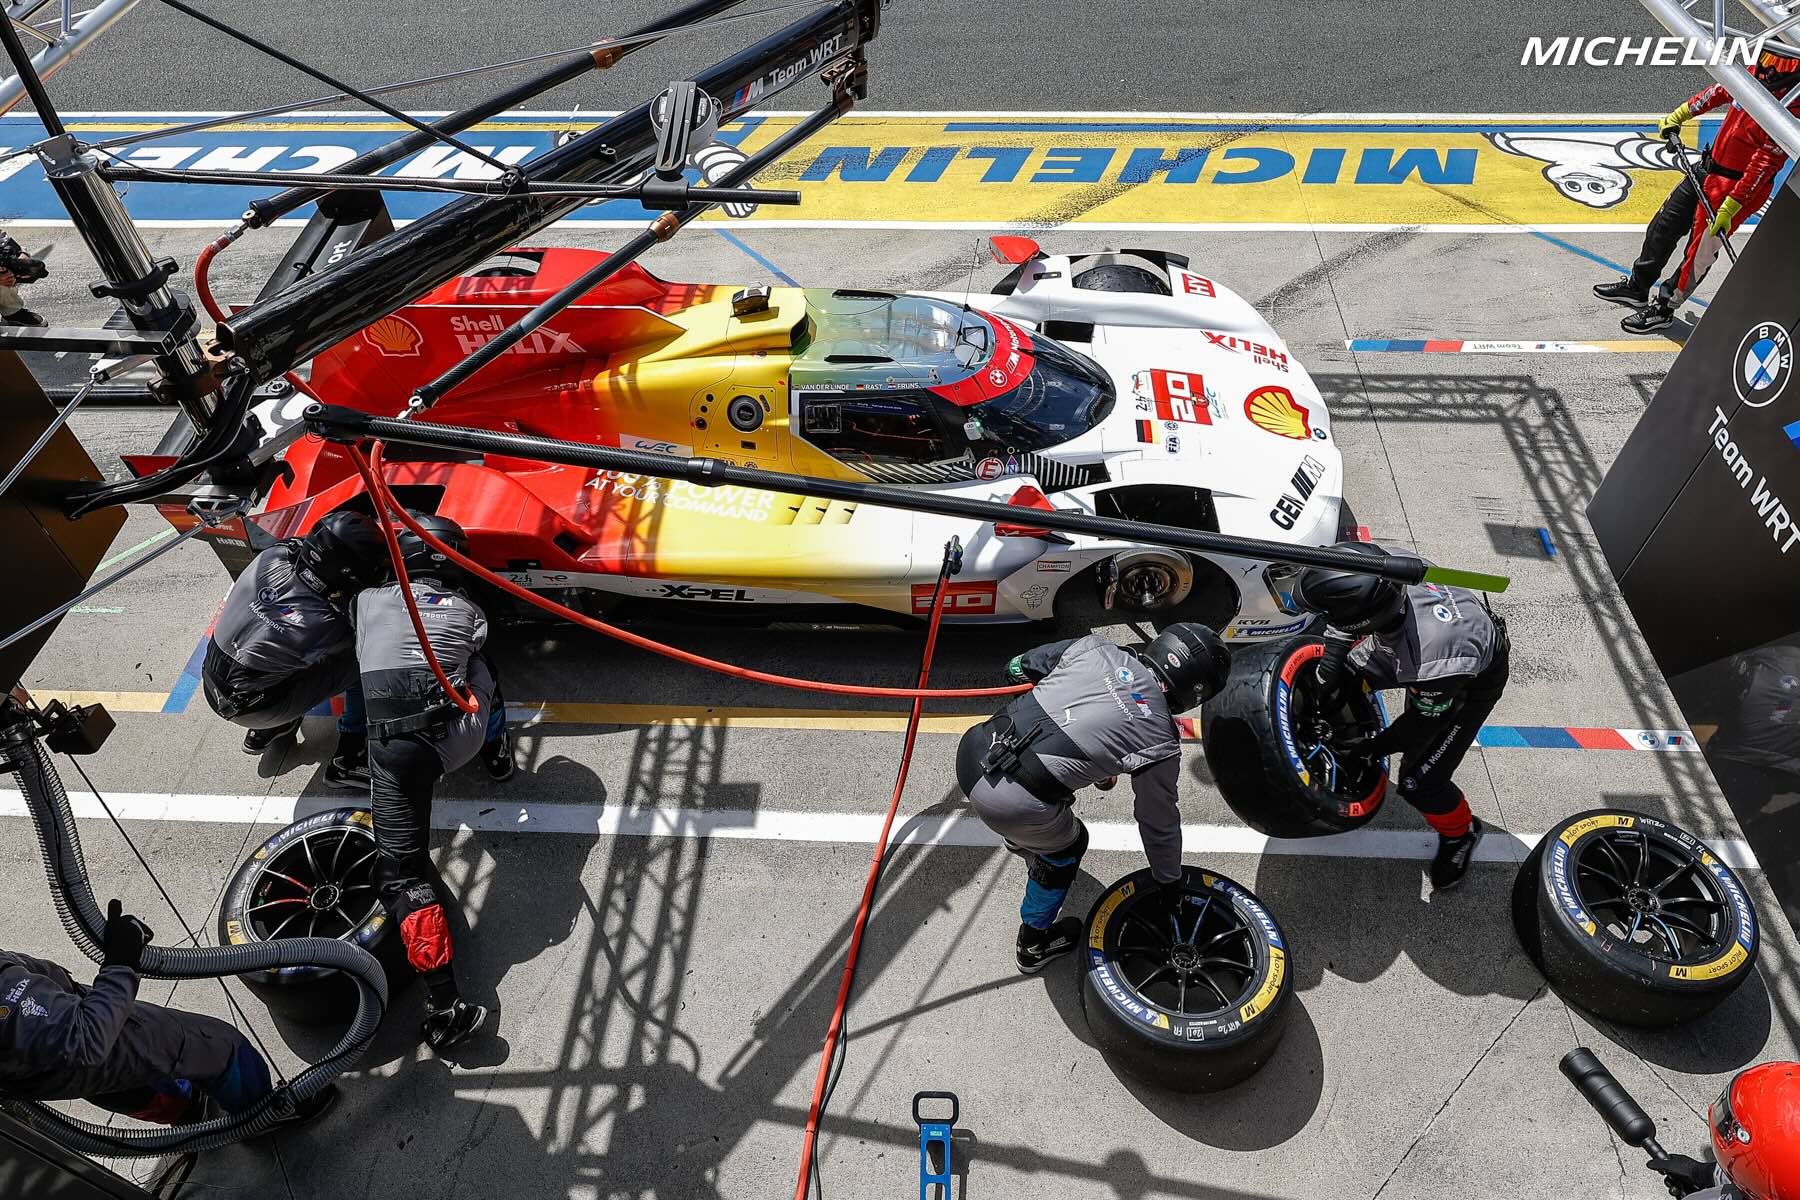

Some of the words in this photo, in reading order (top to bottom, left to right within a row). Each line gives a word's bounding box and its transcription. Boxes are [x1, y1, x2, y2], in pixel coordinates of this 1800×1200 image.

[768, 59, 807, 88] Team
[809, 33, 843, 66] WRT
[798, 146, 1479, 185] MICHELIN
[450, 314, 505, 332] Shell
[455, 328, 586, 355] HLIX
[1201, 331, 1288, 364] HELIX
[1759, 326, 1790, 369] BMW
[1254, 355, 1288, 373] Shell
[1165, 372, 1197, 422] 20
[635, 440, 678, 454] WEC
[1168, 437, 1177, 453] FIA
[981, 460, 998, 479] E
[1008, 464, 1016, 473] N
[1707, 405, 1753, 489] Team
[1750, 475, 1800, 554] WRT
[585, 477, 611, 491] AT
[611, 482, 659, 504] YOUR
[663, 493, 768, 521] COMMAND
[1269, 493, 1305, 531] GEN
[661, 584, 754, 601] XPEL
[249, 601, 284, 633] Motorsport
[1251, 622, 1302, 636] MICHELIN
[1313, 646, 1322, 656] H
[1103, 676, 1134, 721] Motorsport
[1279, 687, 1298, 759] MICHELIN
[1428, 724, 1461, 765] Motorsport
[1566, 828, 1579, 841] PILOT
[1579, 820, 1600, 831] SPORT
[1618, 817, 1628, 826] M
[1555, 846, 1578, 909] MICHELIN
[1121, 885, 1130, 897] M
[1227, 886, 1280, 942] MICHELIN
[1721, 876, 1752, 944] MICHELIN
[229, 923, 240, 934] M
[1708, 961, 1729, 974] SPORT
[1727, 949, 1743, 968] PILOT
[1267, 973, 1279, 995] SPORT
[1676, 967, 1687, 978] M
[10, 978, 31, 1003] HELIX
[1093, 956, 1143, 1015] MICHELIN
[1246, 1004, 1256, 1018] M
[1173, 1025, 1182, 1037] FR
